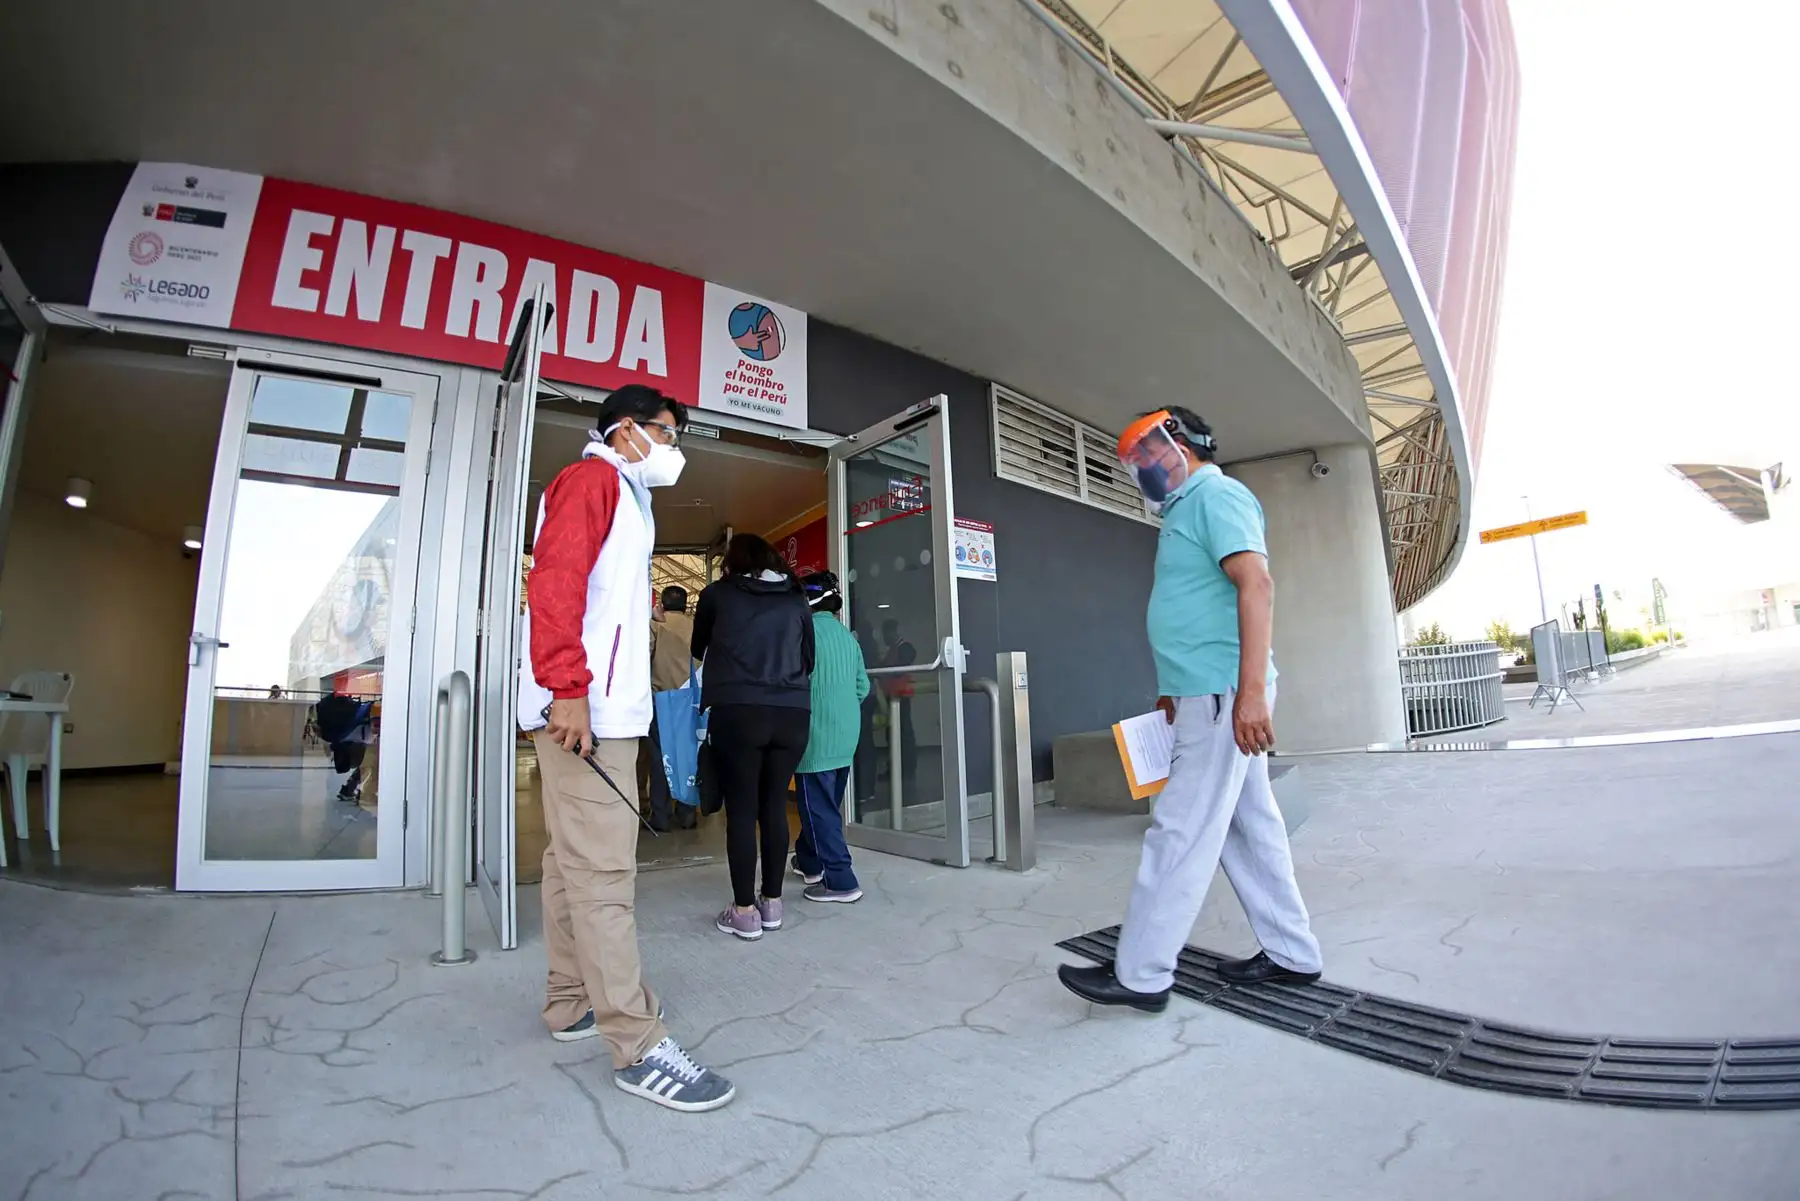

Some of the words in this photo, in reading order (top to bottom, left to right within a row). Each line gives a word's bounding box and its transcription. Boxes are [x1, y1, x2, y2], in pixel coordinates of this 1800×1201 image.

[271, 208, 667, 377] ENTRADA
[725, 369, 736, 380] el
[738, 371, 784, 392] hombro
[737, 360, 773, 378] Pongo
[723, 382, 745, 395] por
[747, 387, 758, 398] el
[760, 389, 787, 405] Perú
[729, 399, 739, 407] YO
[740, 401, 750, 409] ME
[752, 403, 781, 415] VACUNO
